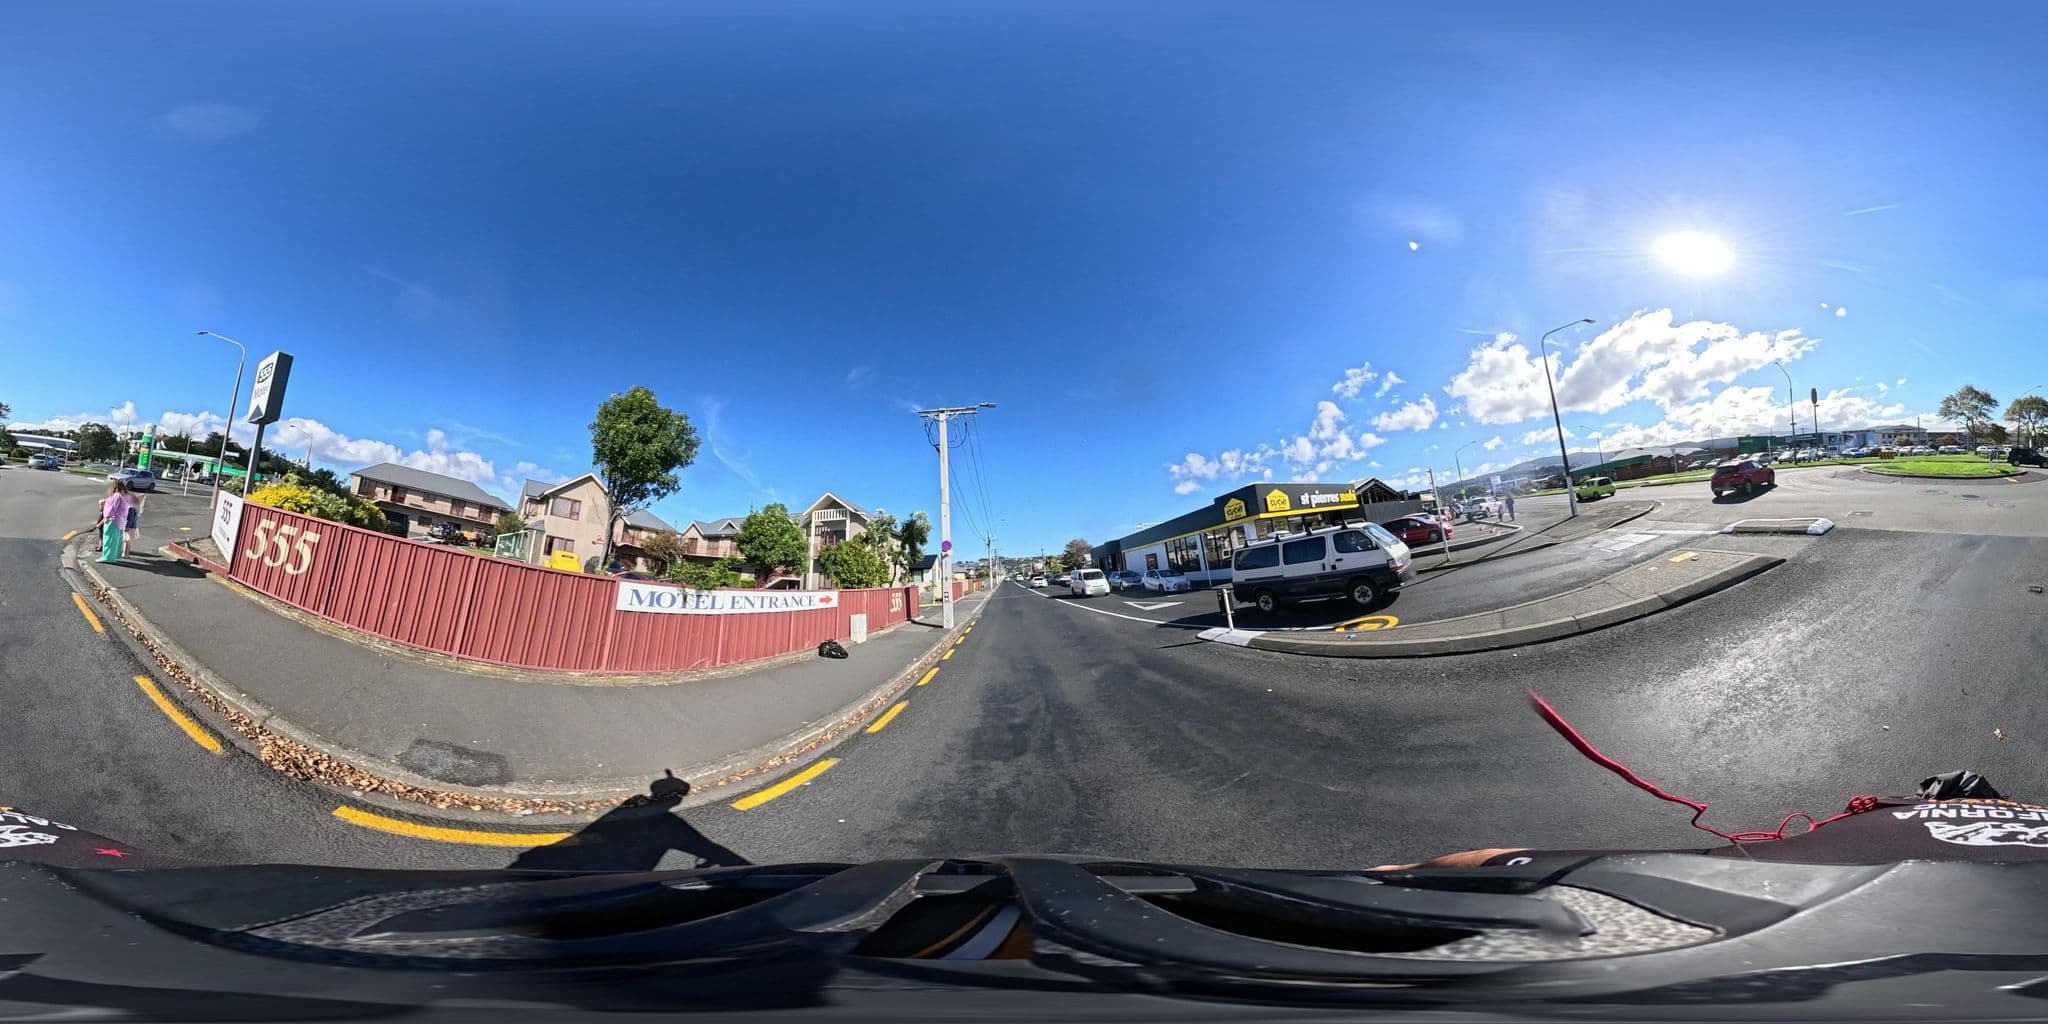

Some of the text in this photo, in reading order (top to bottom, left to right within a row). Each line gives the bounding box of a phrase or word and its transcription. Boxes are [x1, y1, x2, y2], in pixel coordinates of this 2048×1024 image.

[1300, 492, 1310, 505] st
[1310, 490, 1339, 508] pierres
[220, 499, 233, 525] 555
[245, 518, 320, 575] 555
[628, 588, 816, 611] MOTEL ENTRANCE
[890, 592, 902, 613] 555
